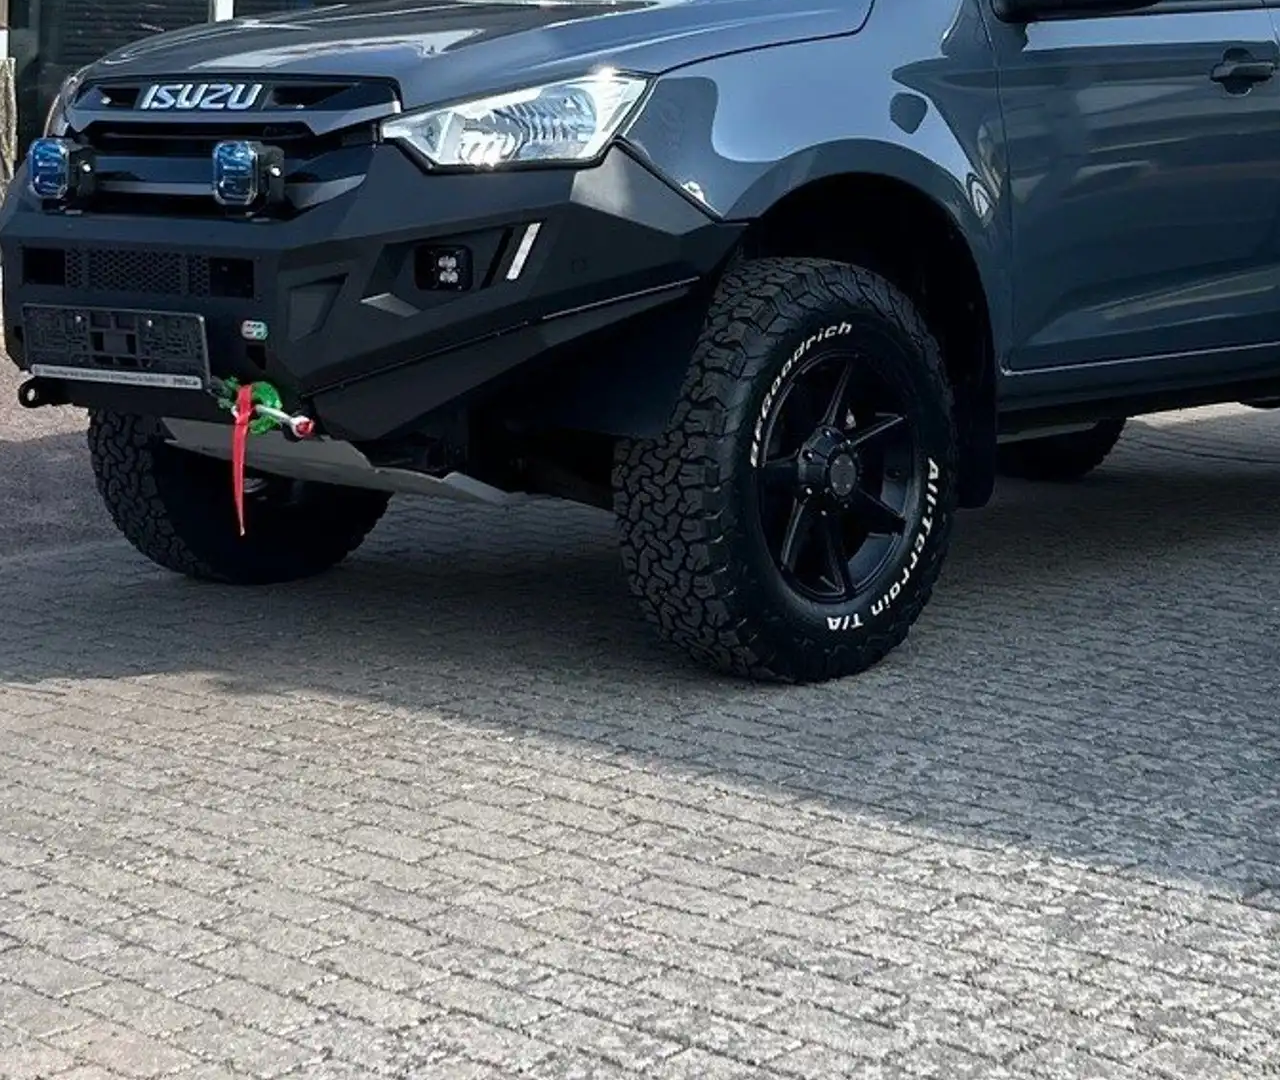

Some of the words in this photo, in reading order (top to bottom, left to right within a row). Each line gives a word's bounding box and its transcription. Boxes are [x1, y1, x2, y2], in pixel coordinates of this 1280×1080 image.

[140, 83, 263, 110] ISUZU
[871, 457, 939, 617] All-Terrain
[827, 613, 865, 631] T/A
